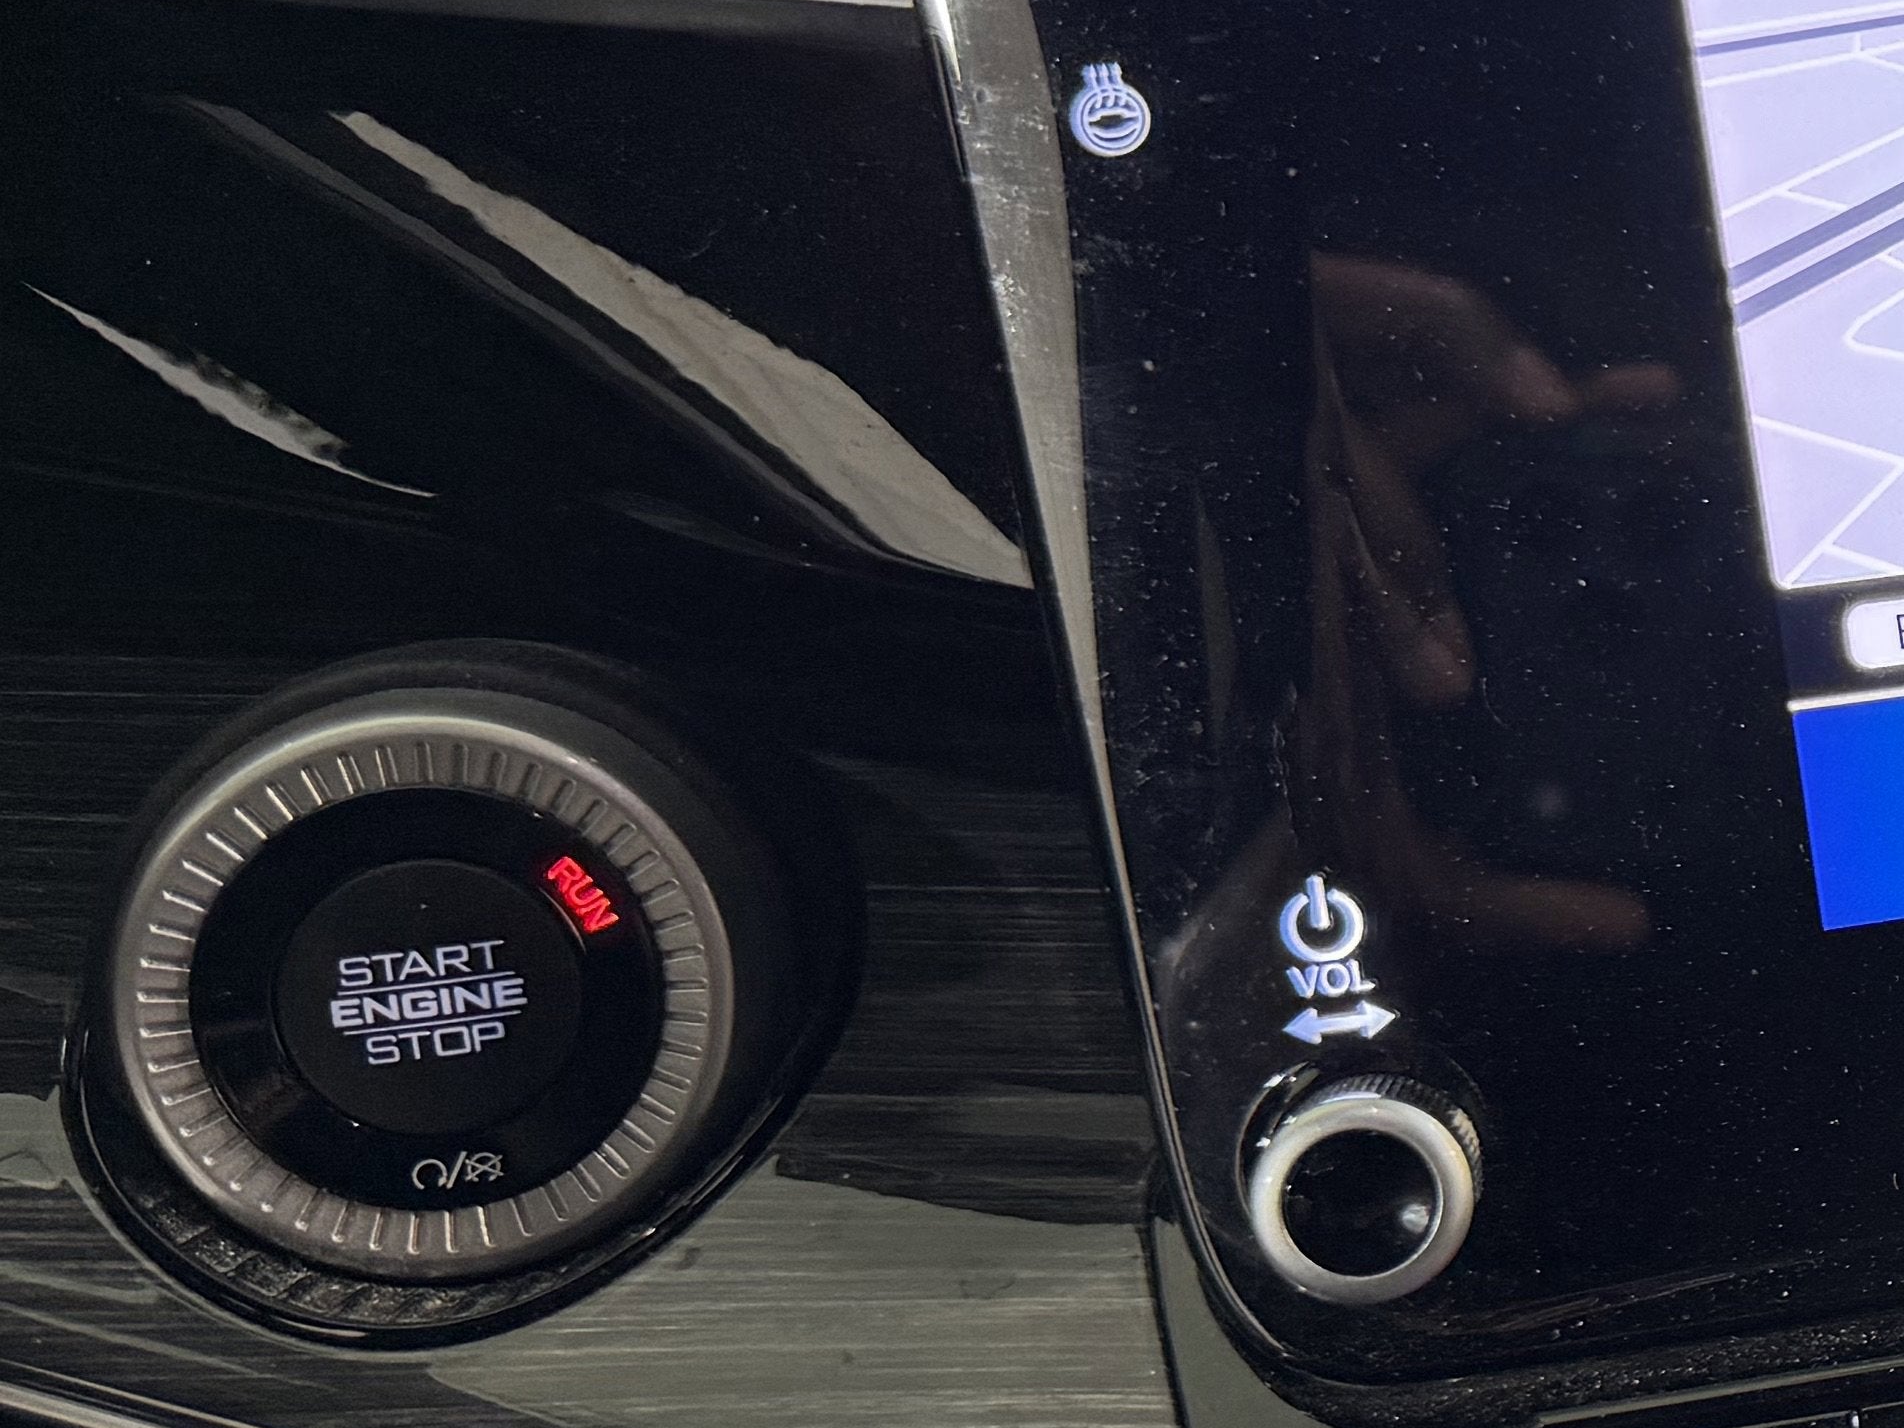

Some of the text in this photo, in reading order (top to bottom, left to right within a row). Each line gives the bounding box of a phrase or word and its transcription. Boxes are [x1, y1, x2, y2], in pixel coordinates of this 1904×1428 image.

[547, 856, 619, 933] RUN
[339, 939, 504, 988] START
[1285, 958, 1376, 999] VOL
[330, 977, 528, 1030] ENGINE
[367, 1021, 505, 1066] STOP
